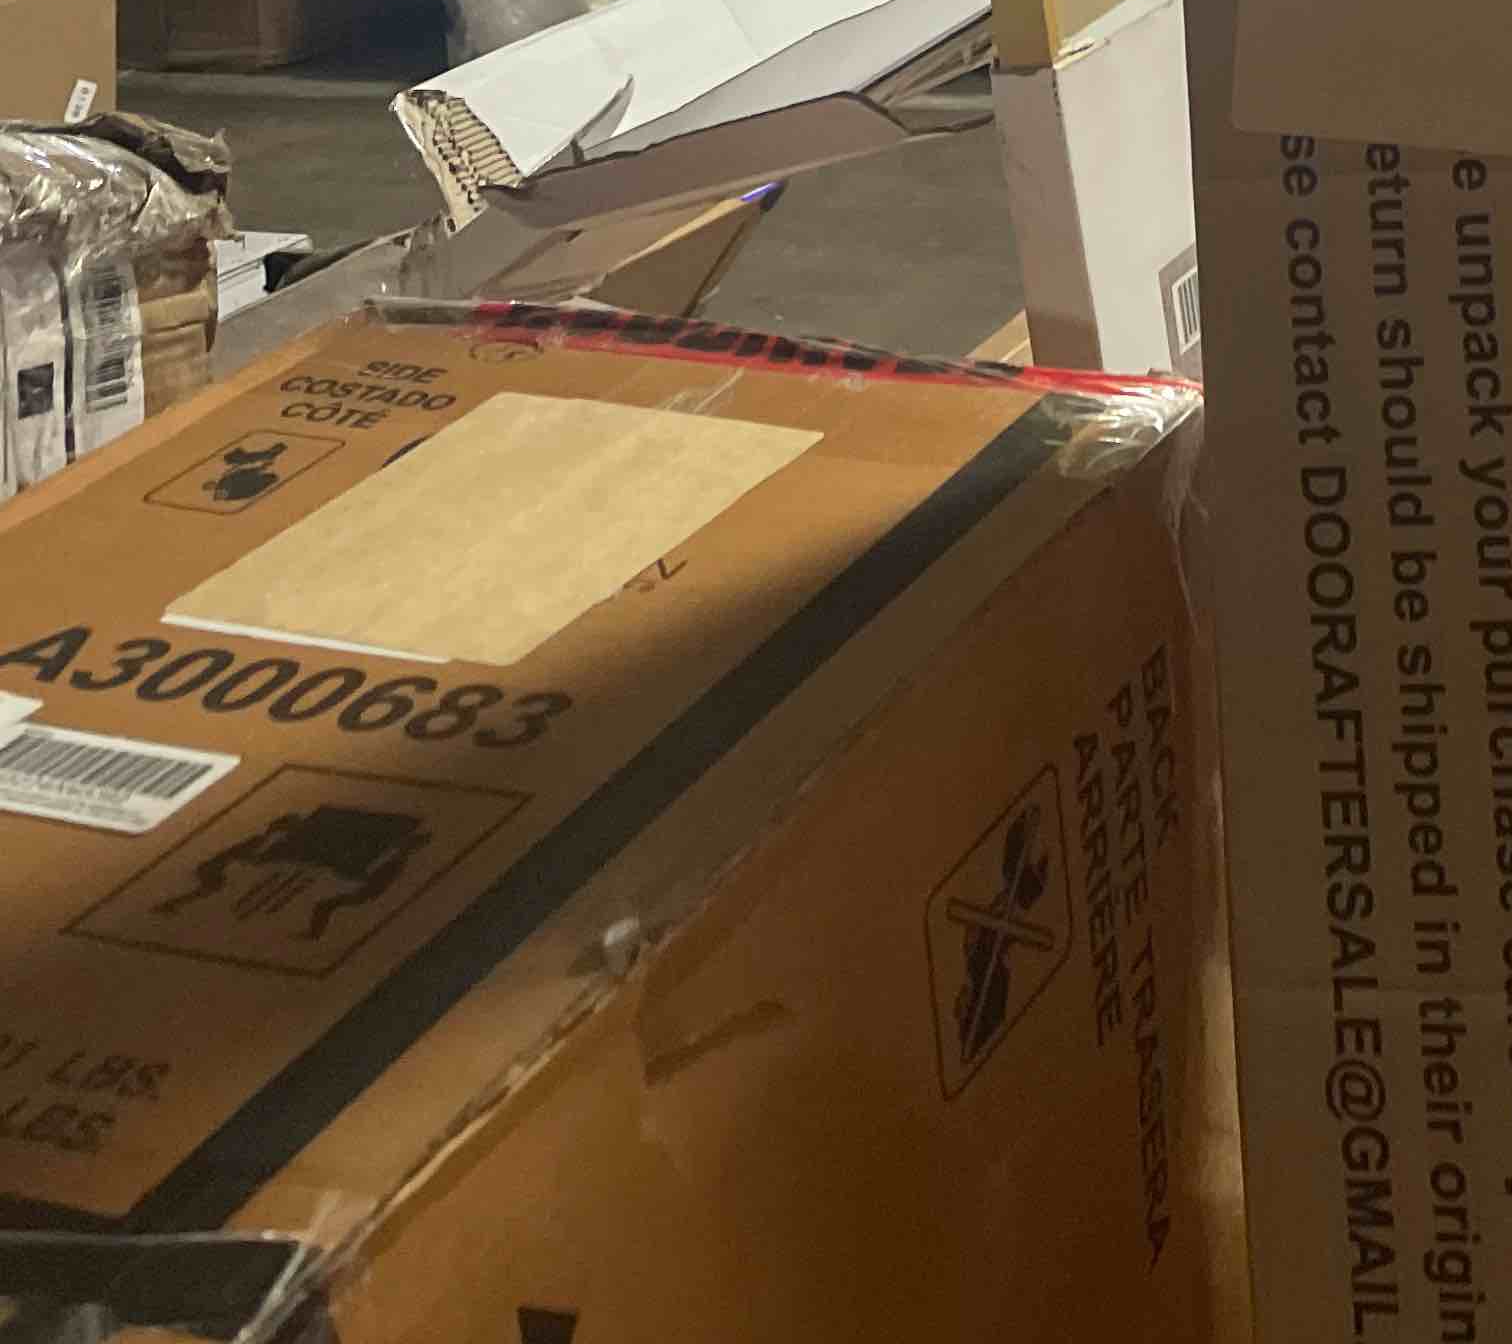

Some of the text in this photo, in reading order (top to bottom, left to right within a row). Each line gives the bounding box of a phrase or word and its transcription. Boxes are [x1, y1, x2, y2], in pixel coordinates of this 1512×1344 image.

[1280, 135, 1317, 197] se
[1452, 159, 1487, 191] e
[277, 375, 457, 412] COSTADO
[1285, 218, 1340, 448] contact
[0, 624, 575, 749] A3000683
[1141, 645, 1180, 850] BACK
[1366, 143, 1487, 1344] eturn should be shipped in their origin
[1107, 683, 1173, 1269] PARTE TRASERA
